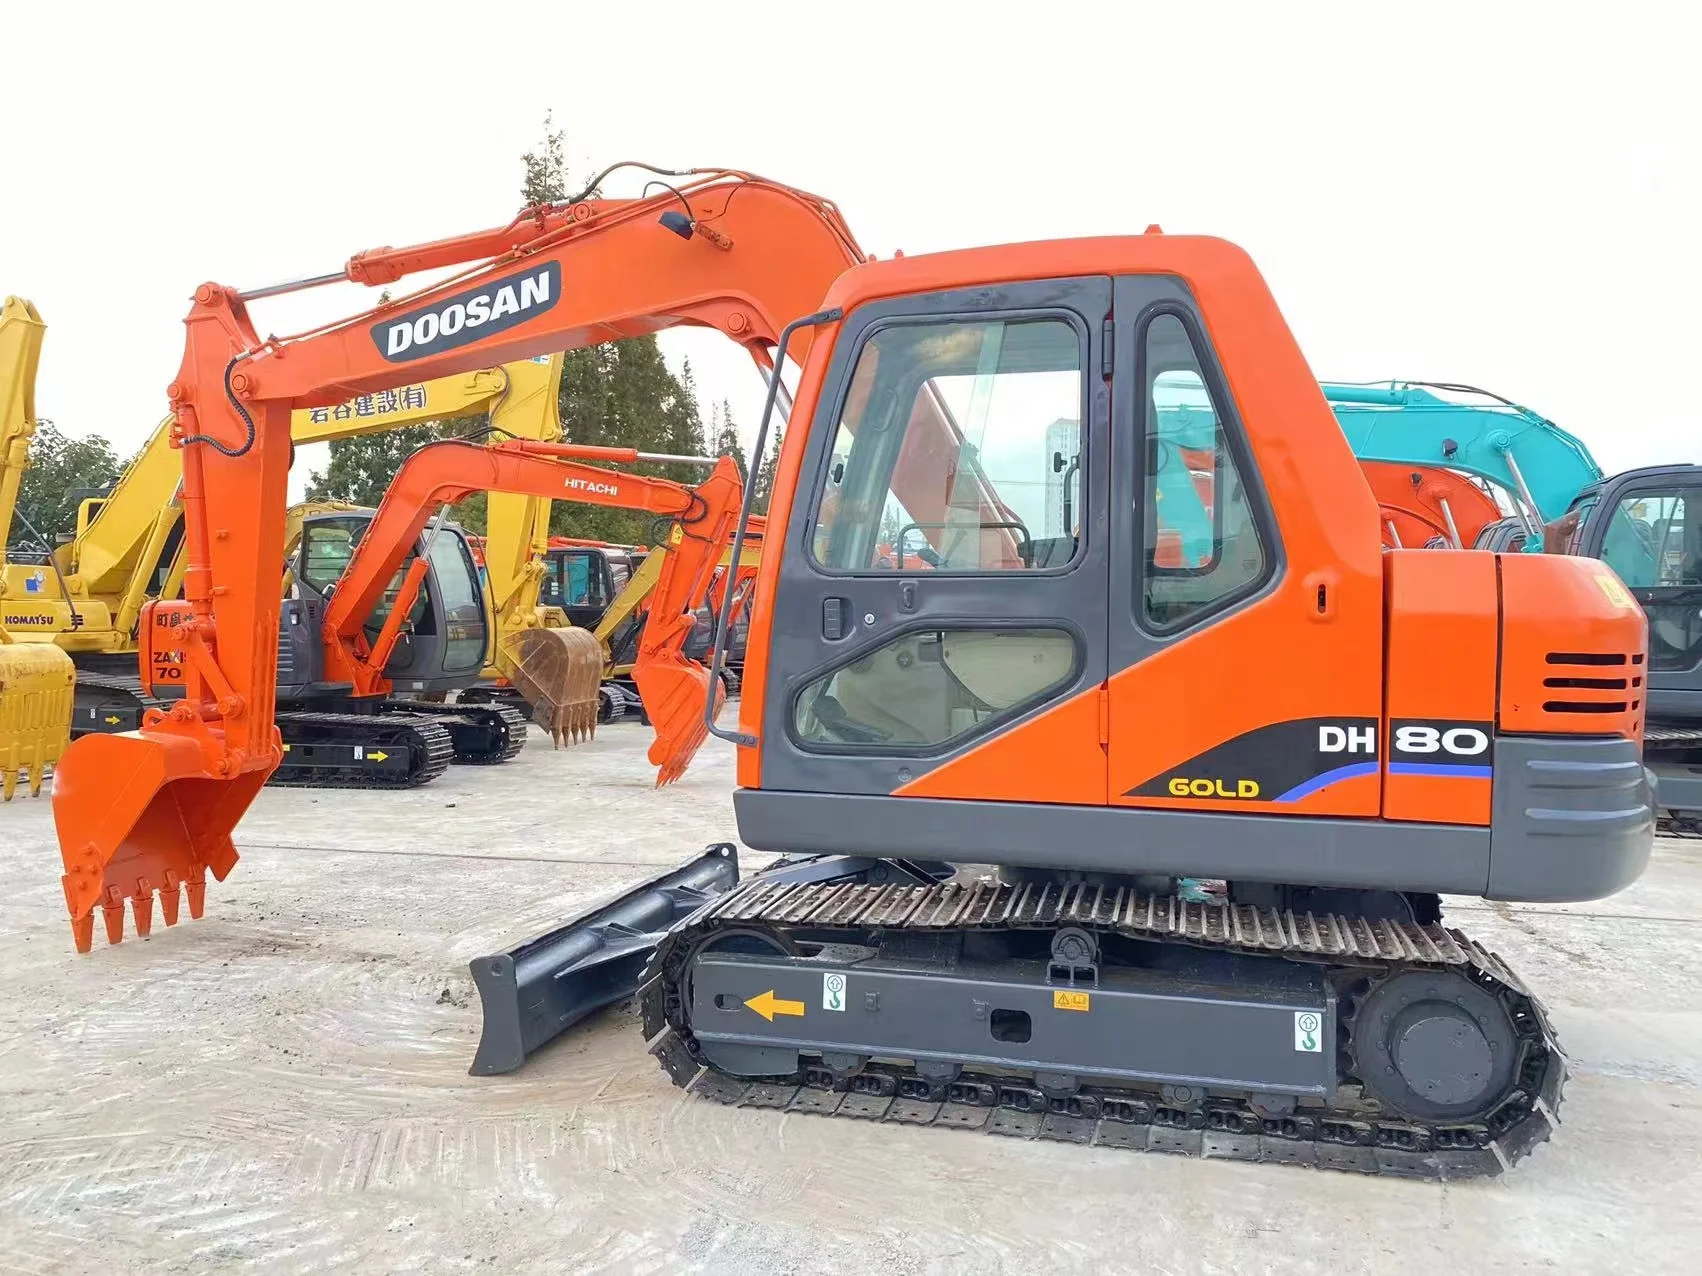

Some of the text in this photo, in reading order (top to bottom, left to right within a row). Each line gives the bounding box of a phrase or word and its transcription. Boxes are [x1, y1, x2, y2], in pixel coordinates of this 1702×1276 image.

[387, 271, 550, 356] DOOSAN
[564, 477, 618, 496] HITACHI
[5, 614, 54, 625] KOMATSU
[153, 651, 187, 664] ZAXI
[156, 667, 181, 679] 70
[1319, 726, 1489, 755] DH 80
[1168, 778, 1260, 798] GOLD
